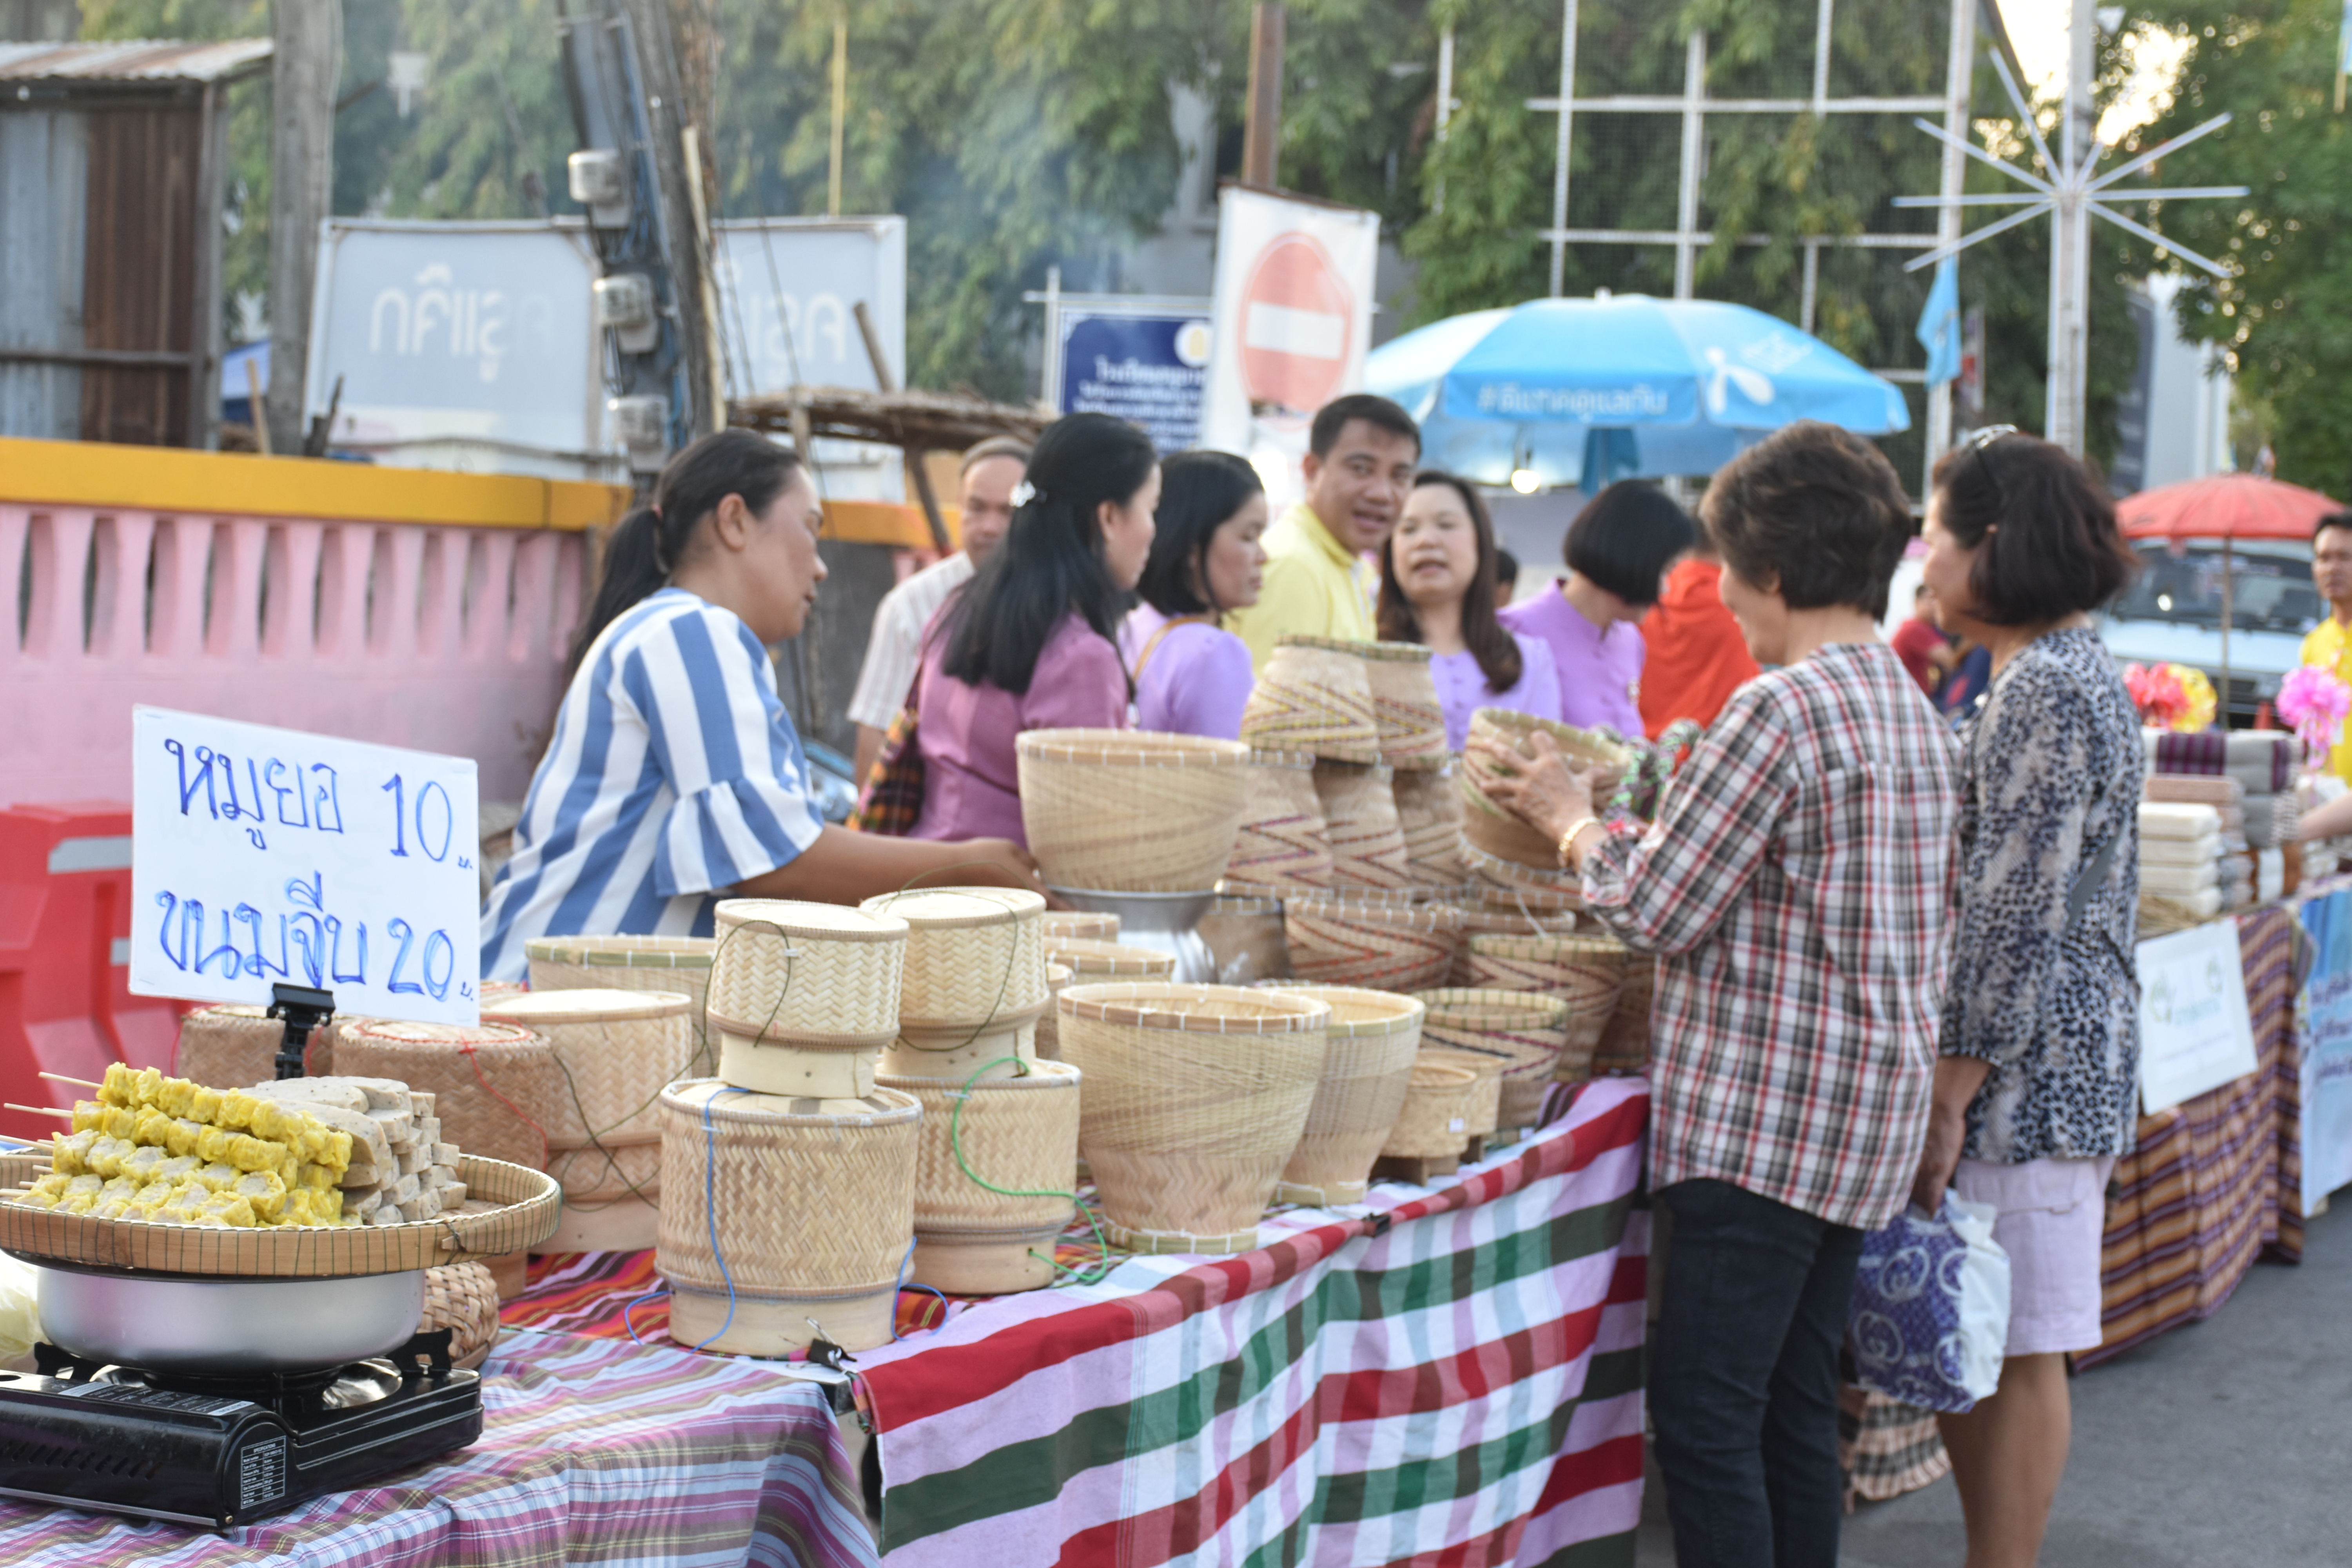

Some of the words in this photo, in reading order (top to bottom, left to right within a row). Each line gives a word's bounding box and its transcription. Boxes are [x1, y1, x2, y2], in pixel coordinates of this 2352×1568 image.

[165, 738, 344, 850] หมูยอ
[155, 871, 368, 989] ขนมจีบ
